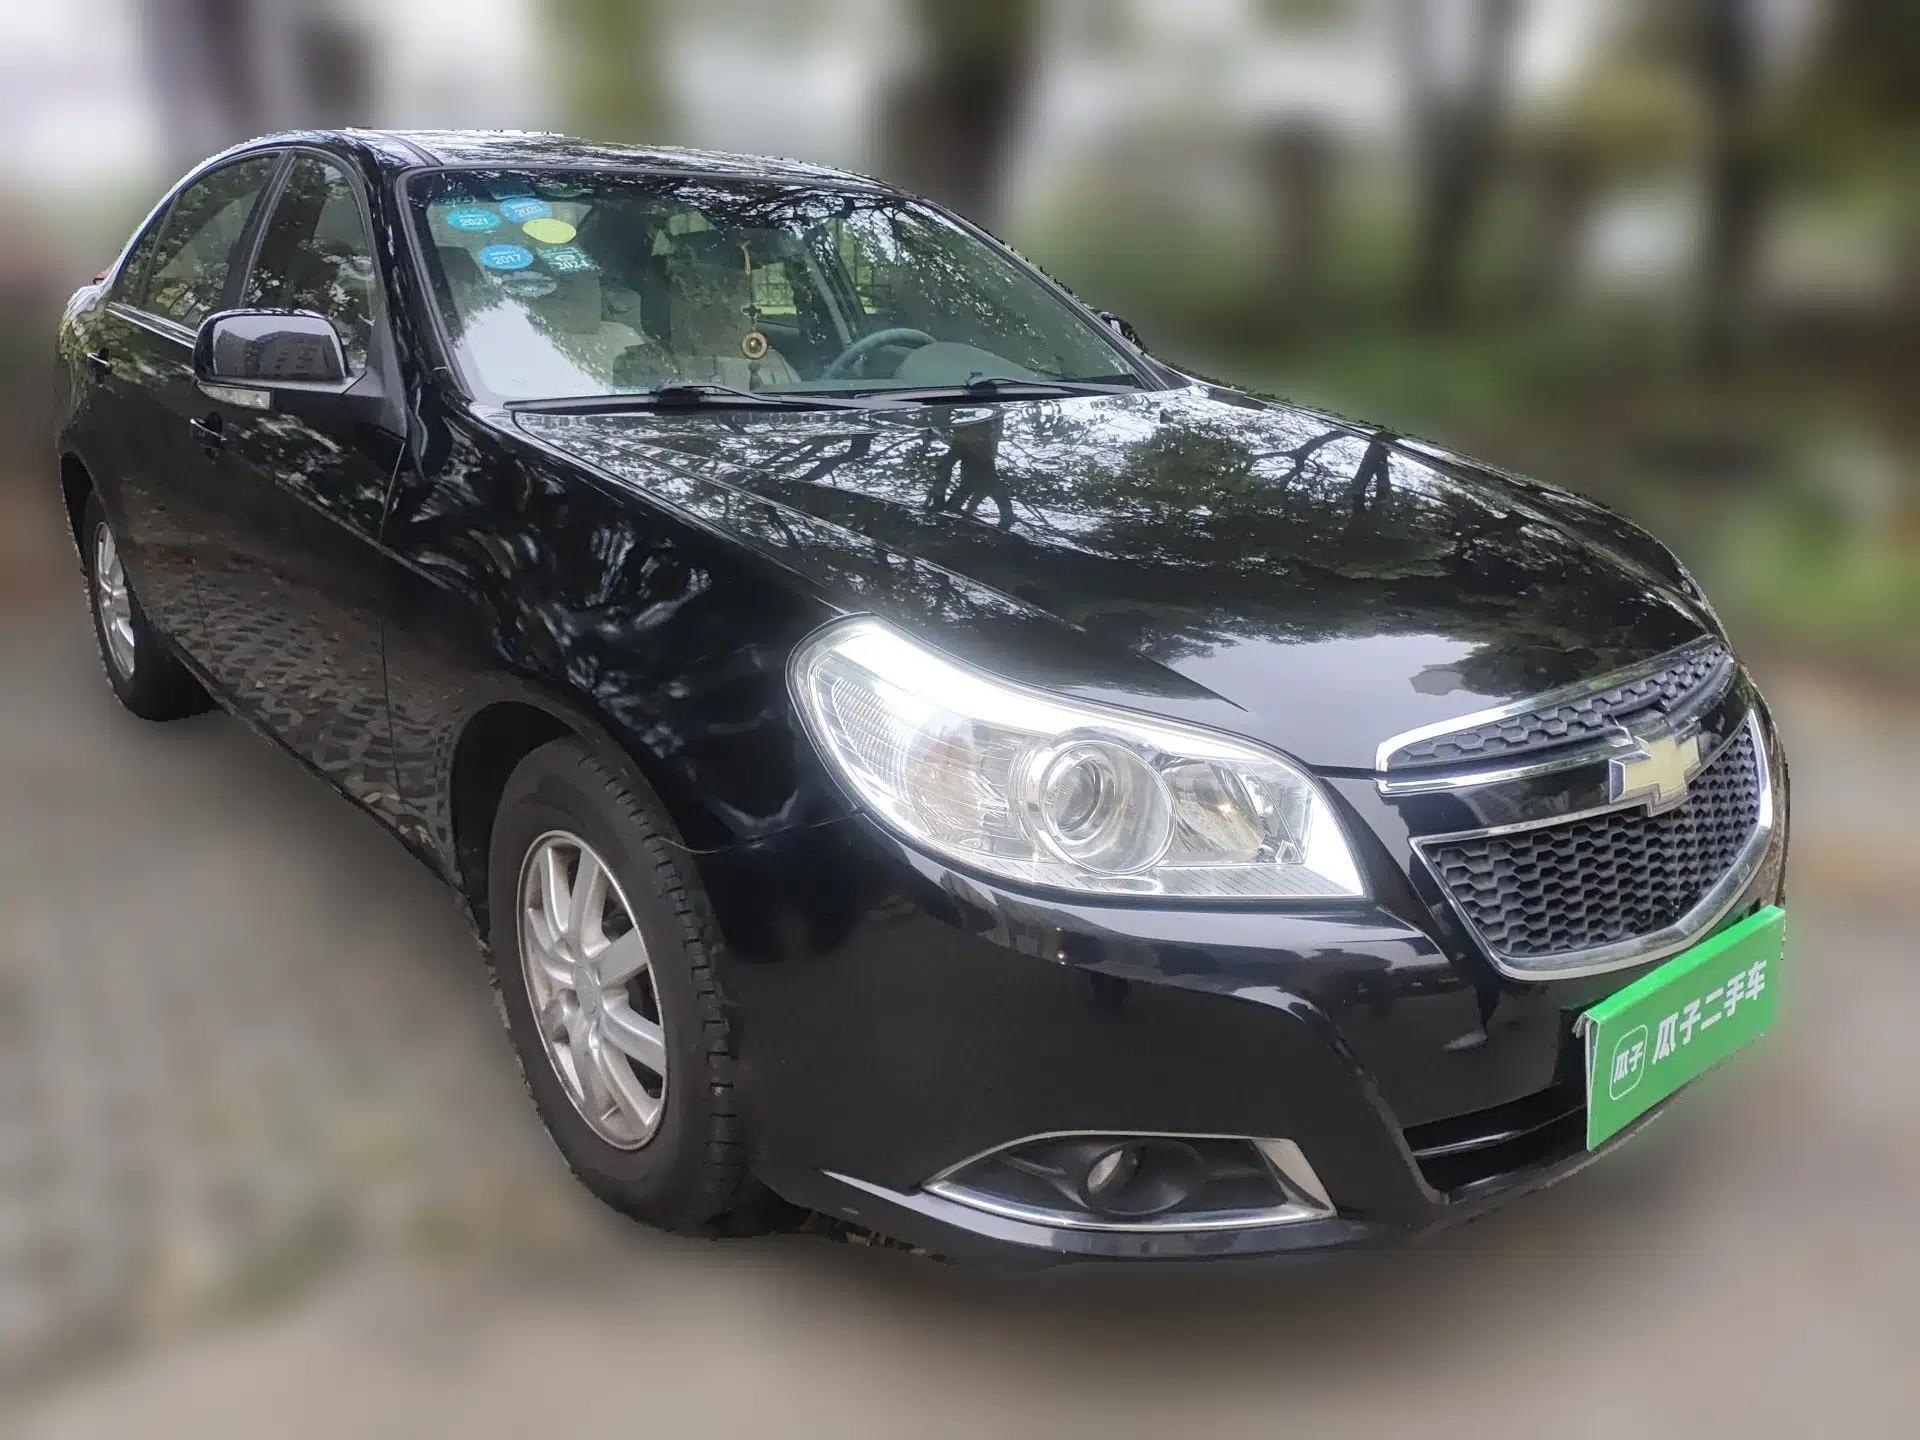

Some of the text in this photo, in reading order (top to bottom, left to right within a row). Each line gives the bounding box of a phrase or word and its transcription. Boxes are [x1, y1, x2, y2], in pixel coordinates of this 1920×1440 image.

[492, 254, 520, 265] 2017
[1652, 960, 1767, 1064] 瓜子二手车
[1613, 1041, 1644, 1083] 瓜子
